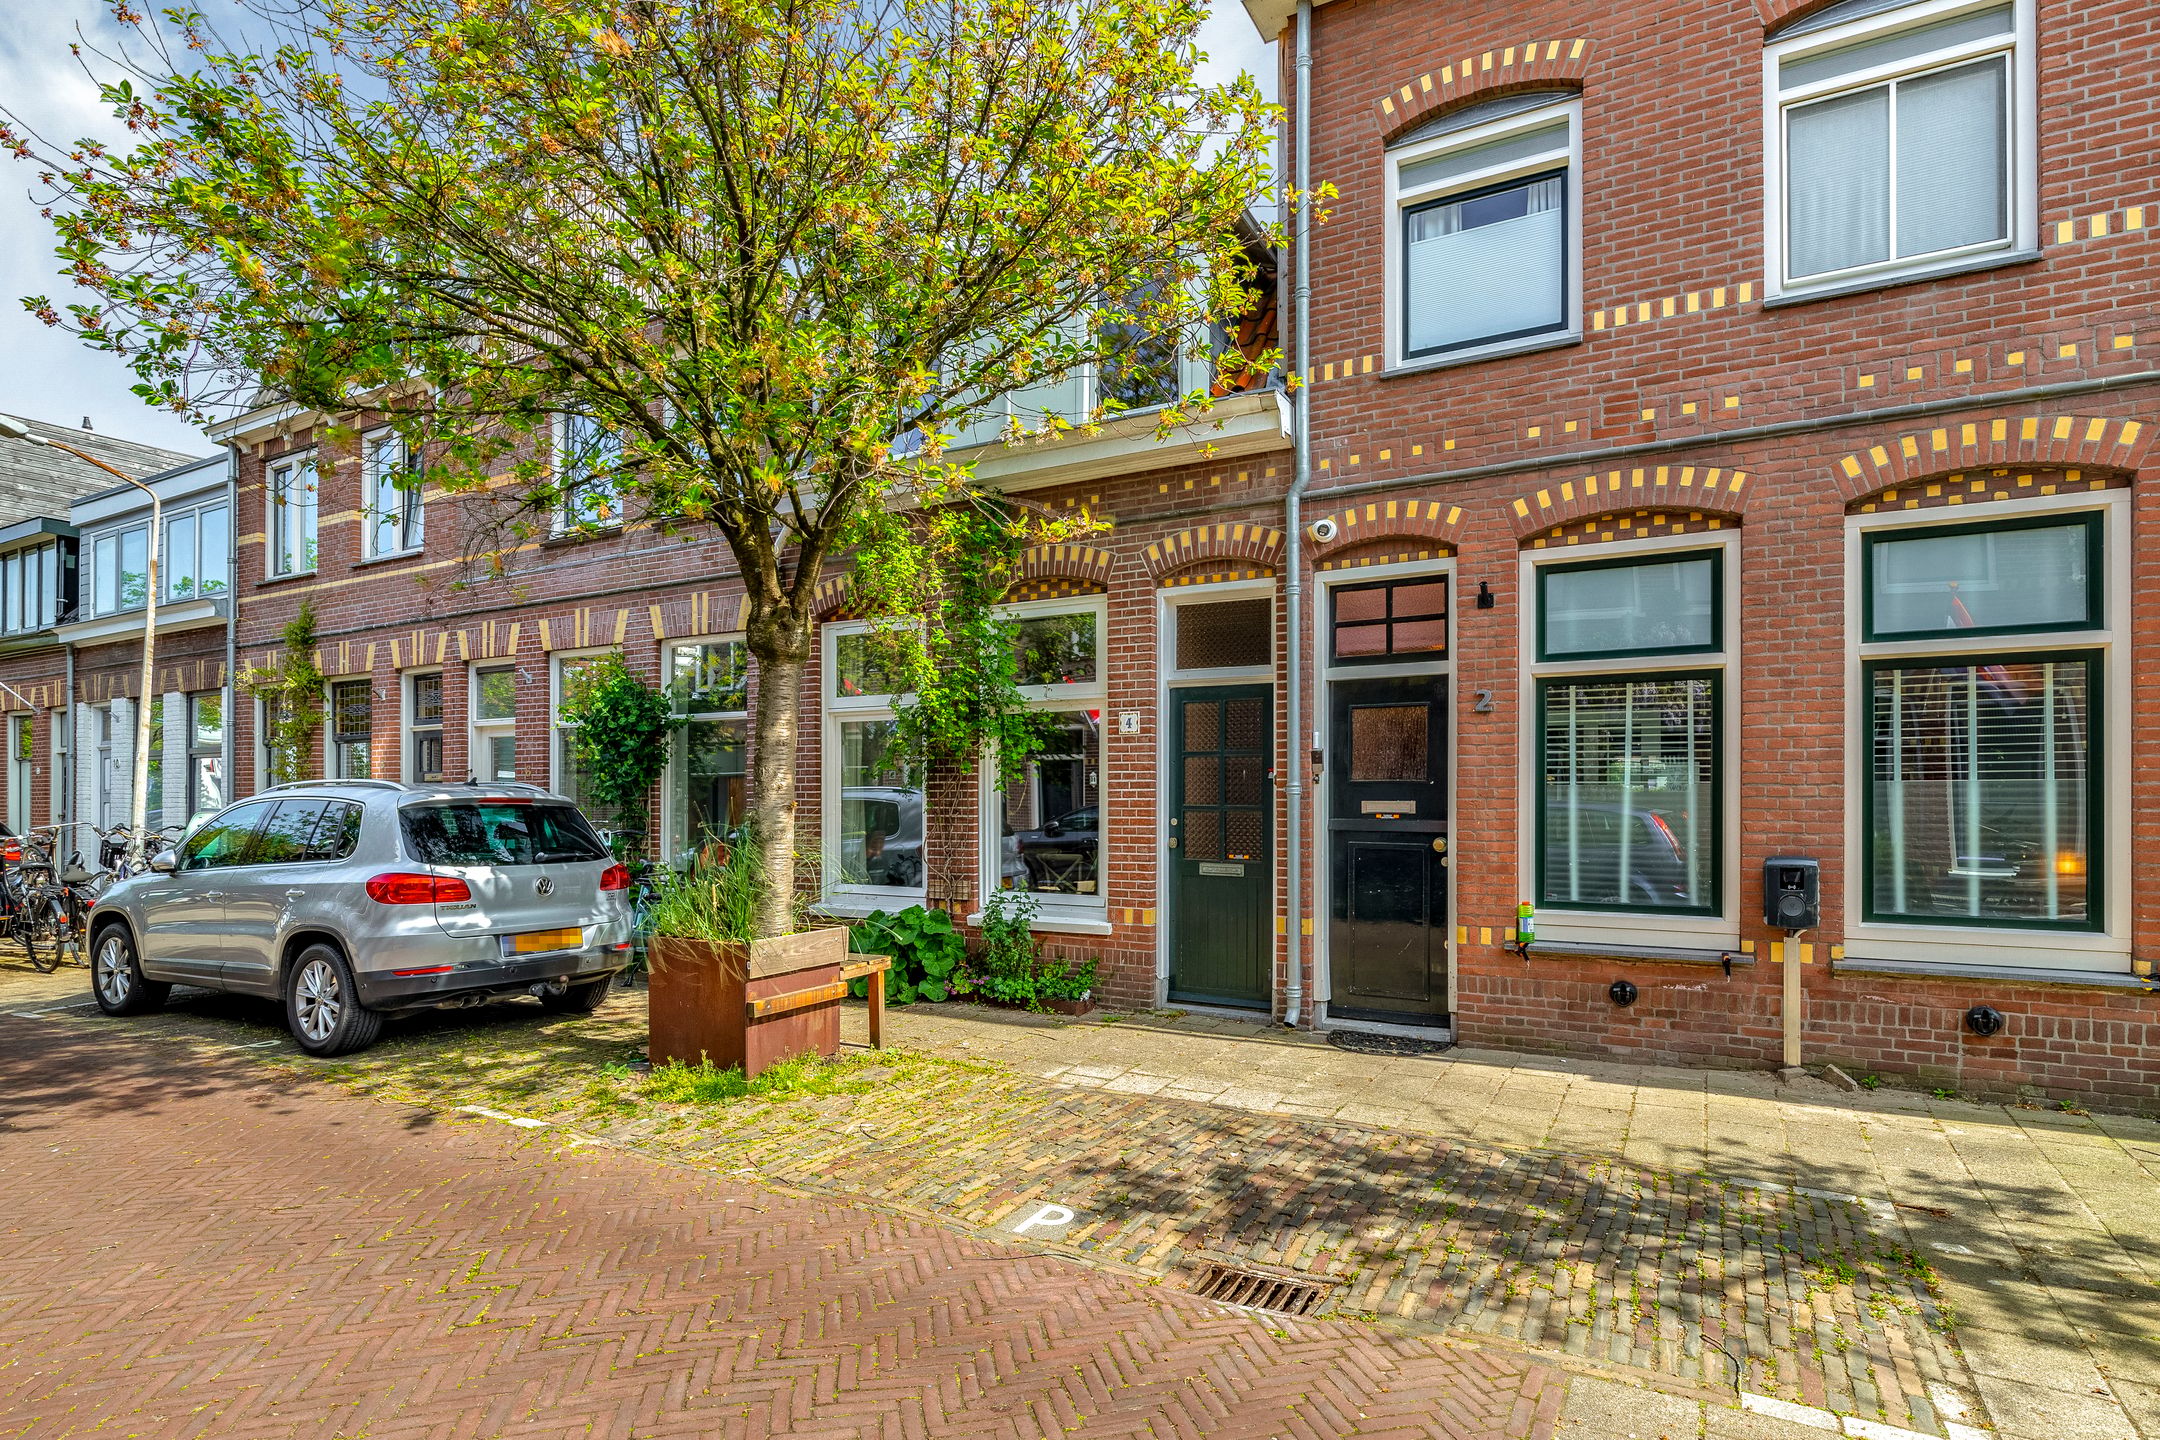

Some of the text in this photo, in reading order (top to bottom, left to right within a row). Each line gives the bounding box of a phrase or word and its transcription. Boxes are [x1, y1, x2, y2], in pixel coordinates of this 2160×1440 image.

[1475, 689, 1494, 712] 2
[1125, 717, 1133, 729] 4
[1012, 1204, 1074, 1233] P
